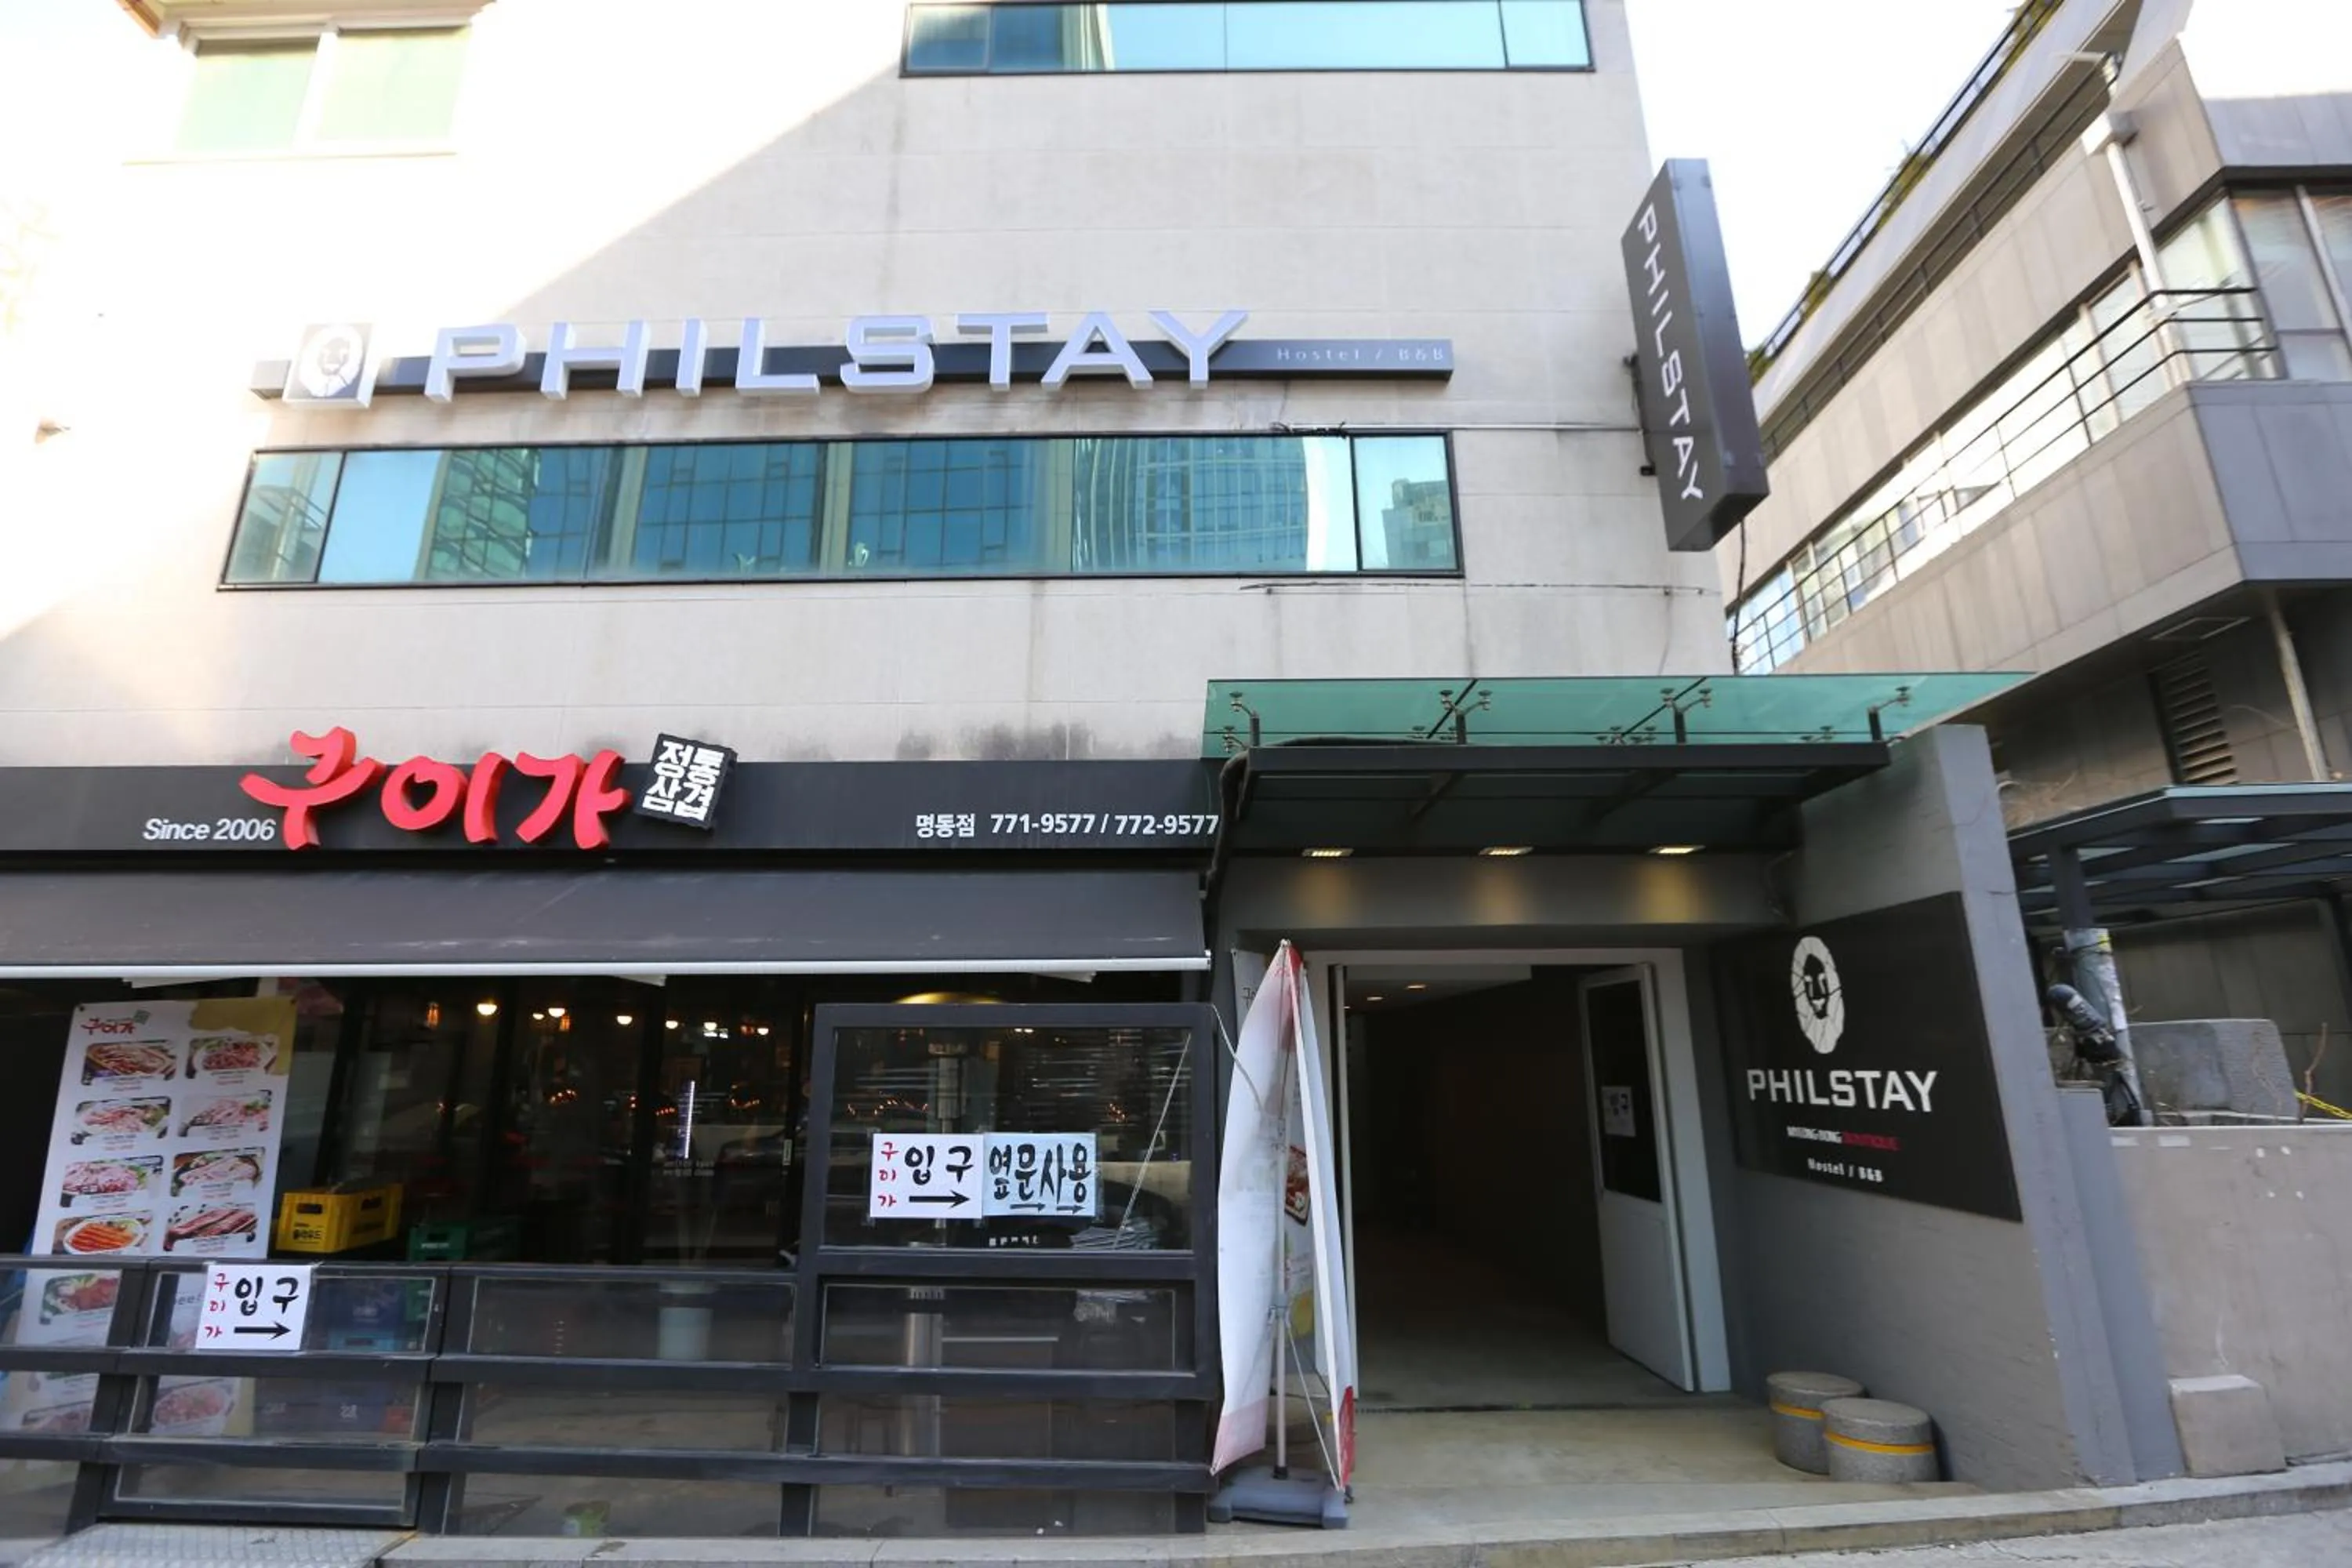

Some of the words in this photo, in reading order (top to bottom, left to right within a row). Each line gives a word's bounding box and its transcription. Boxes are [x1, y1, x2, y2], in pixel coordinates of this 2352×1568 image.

[423, 310, 1248, 403] PHILSTAY
[1276, 347, 1360, 361] Hostel
[1637, 202, 1704, 500] PHILSTAY
[653, 740, 725, 786] 정통
[641, 781, 716, 822] 삼겹
[143, 818, 211, 840] Since
[212, 818, 277, 841] 2006
[915, 813, 976, 839] 명동점
[990, 814, 1096, 834] 771-9577
[1114, 815, 1220, 836] 772-9577
[1745, 1068, 1938, 1113] PHILSTAY
[904, 1145, 973, 1186] 입구
[234, 1276, 299, 1316] 입구
